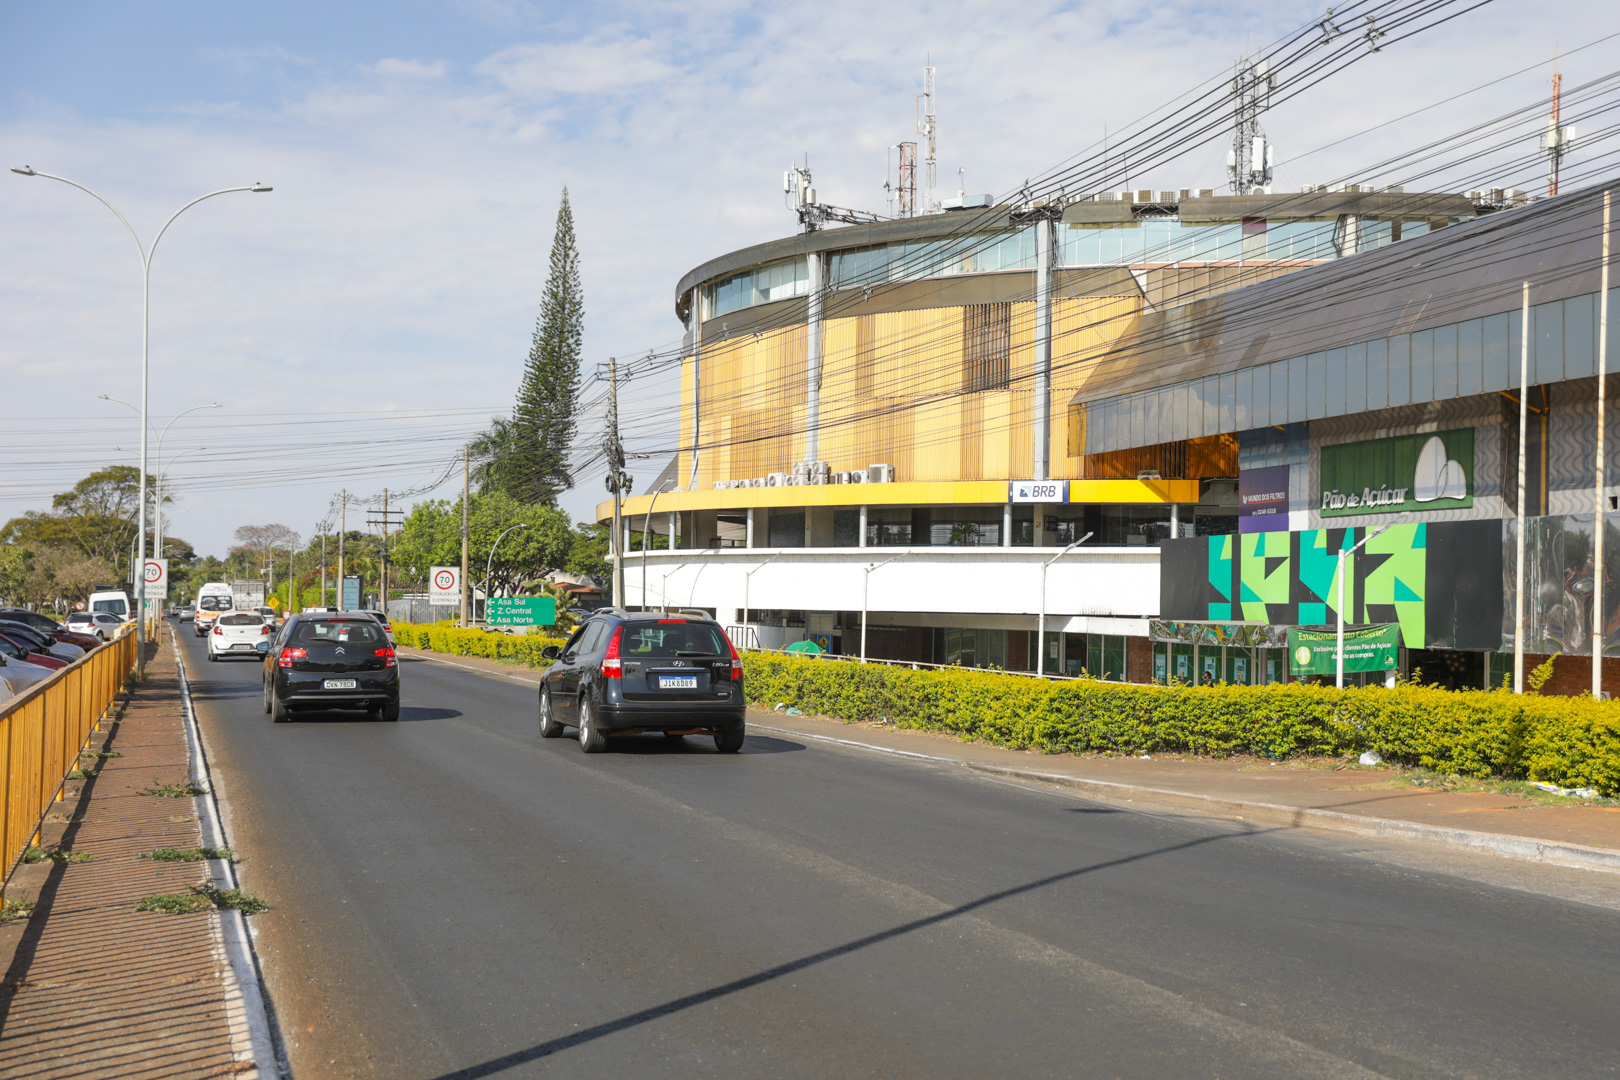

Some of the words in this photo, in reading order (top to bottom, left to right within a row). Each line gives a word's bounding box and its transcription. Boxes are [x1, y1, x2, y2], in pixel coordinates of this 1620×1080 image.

[1032, 485, 1056, 498] BRB
[1248, 494, 1261, 502] MUNDO
[1270, 492, 1285, 500] FILTROS
[1322, 489, 1346, 510] Pão
[1347, 493, 1359, 508] de
[1360, 484, 1408, 509] Açúcar
[439, 576, 450, 584] 70
[1298, 631, 1355, 641] Estacionamnto
[1376, 642, 1392, 650] Açúcar
